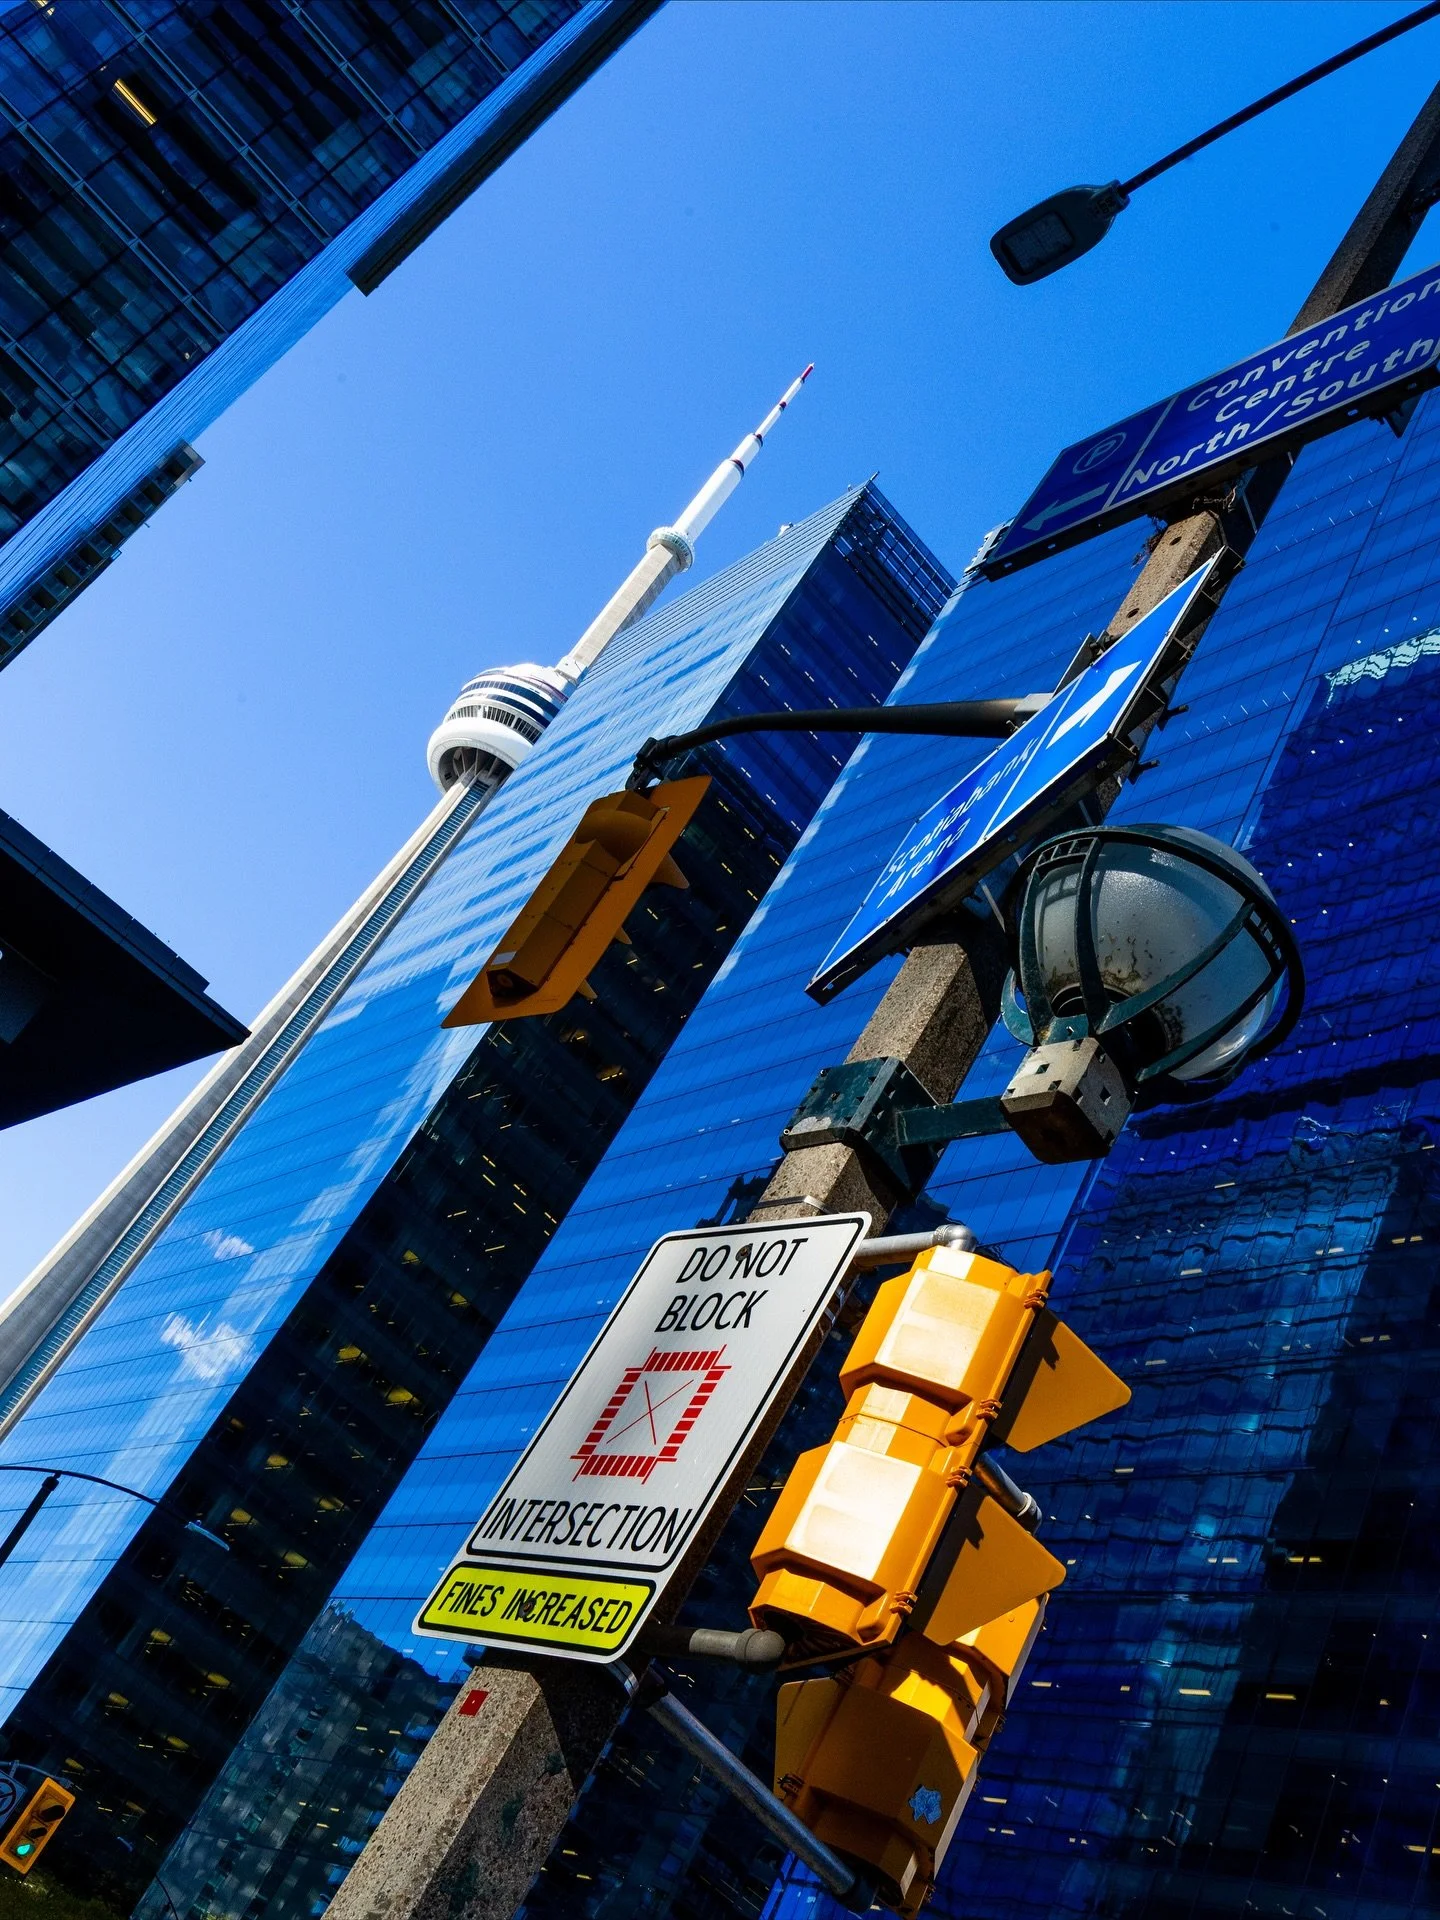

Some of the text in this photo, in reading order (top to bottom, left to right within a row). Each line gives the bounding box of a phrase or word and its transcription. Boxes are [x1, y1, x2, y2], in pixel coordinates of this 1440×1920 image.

[1187, 279, 1440, 412] Convention
[1122, 338, 1434, 493] North/South
[1215, 339, 1371, 423] Centre
[1084, 439, 1117, 467] P
[879, 736, 1039, 887] Scotiabank
[876, 817, 971, 910] Arena
[676, 1238, 808, 1283] DO NOT
[654, 1289, 768, 1333] BLOCK
[482, 1497, 692, 1554] INTERSECTION
[438, 1581, 634, 1634] FINES INCREASED
